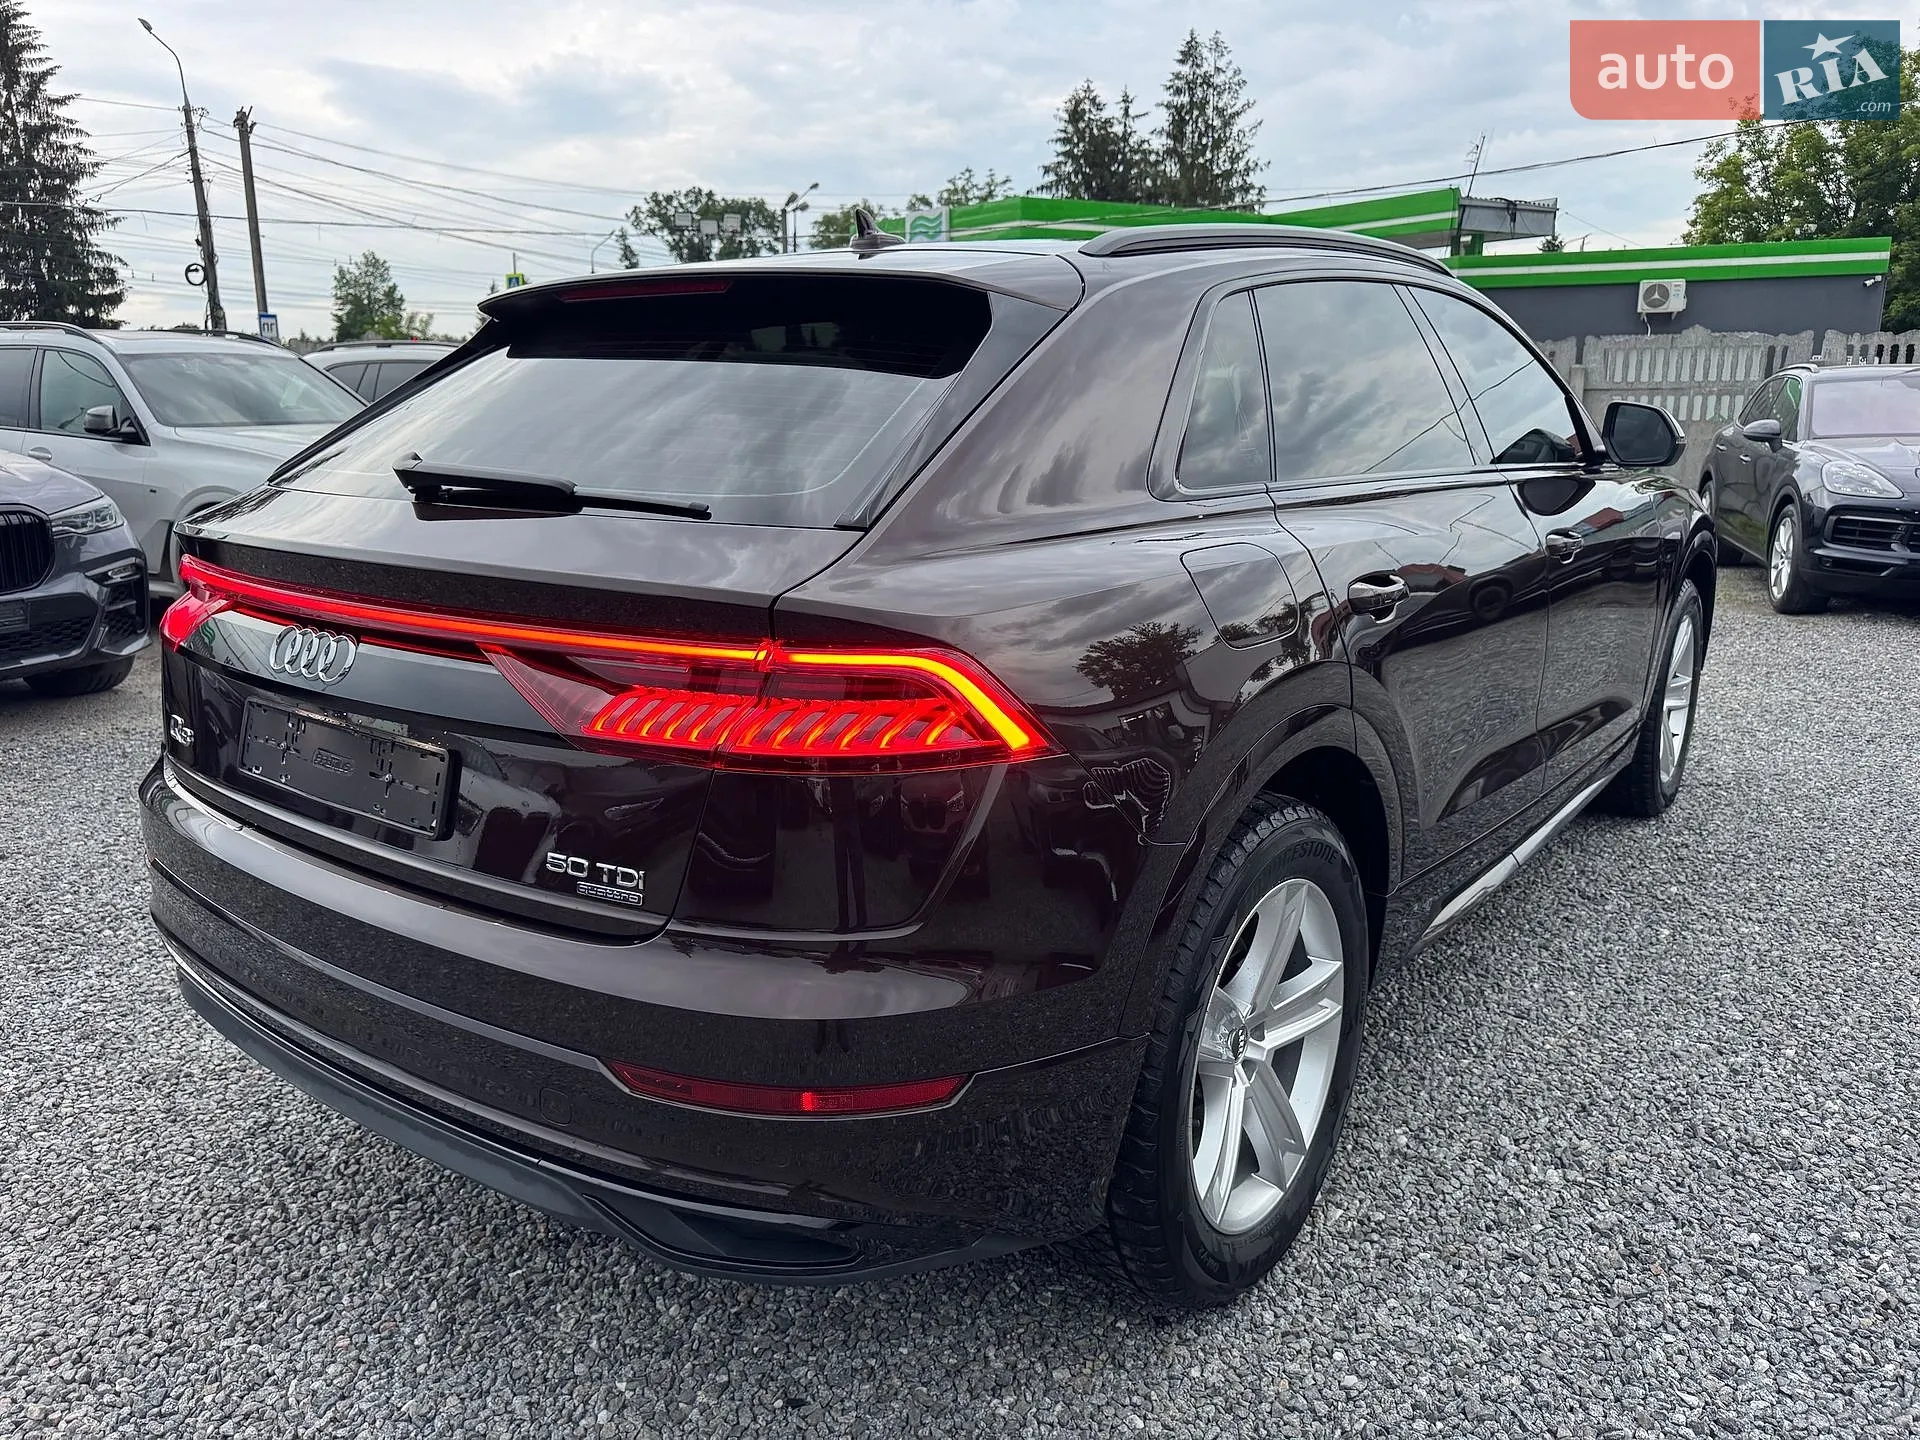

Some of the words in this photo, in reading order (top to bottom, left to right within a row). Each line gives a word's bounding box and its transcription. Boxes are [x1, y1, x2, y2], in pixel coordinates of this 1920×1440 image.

[546, 852, 589, 878] 50
[595, 862, 645, 890] TDI
[578, 883, 641, 904] quattro
